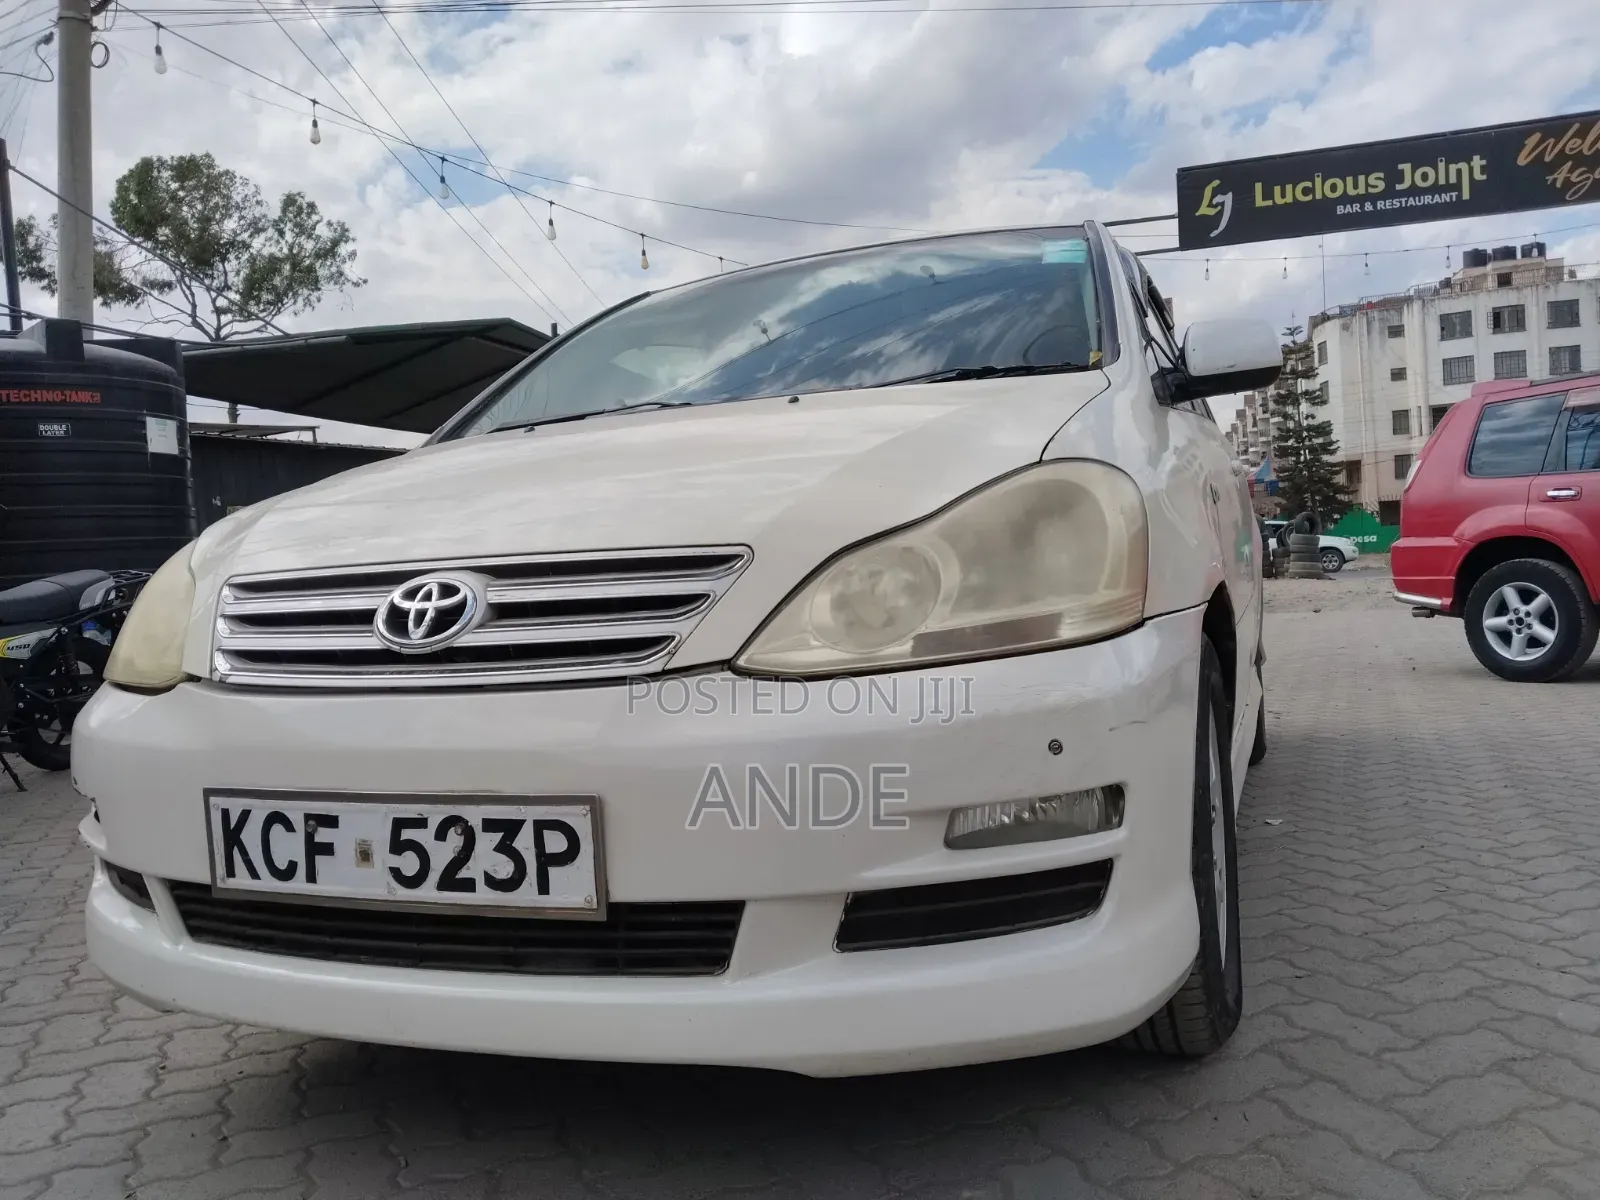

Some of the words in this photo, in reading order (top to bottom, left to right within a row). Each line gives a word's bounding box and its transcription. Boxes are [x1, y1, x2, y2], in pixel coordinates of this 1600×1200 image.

[1254, 173, 1386, 207] Lucious
[1395, 154, 1488, 201] Joint
[1336, 203, 1362, 215] BAR
[1364, 201, 1374, 212] &
[1377, 192, 1459, 210] RESTAURANT
[220, 807, 340, 884] KCF
[388, 814, 581, 896] 523P
